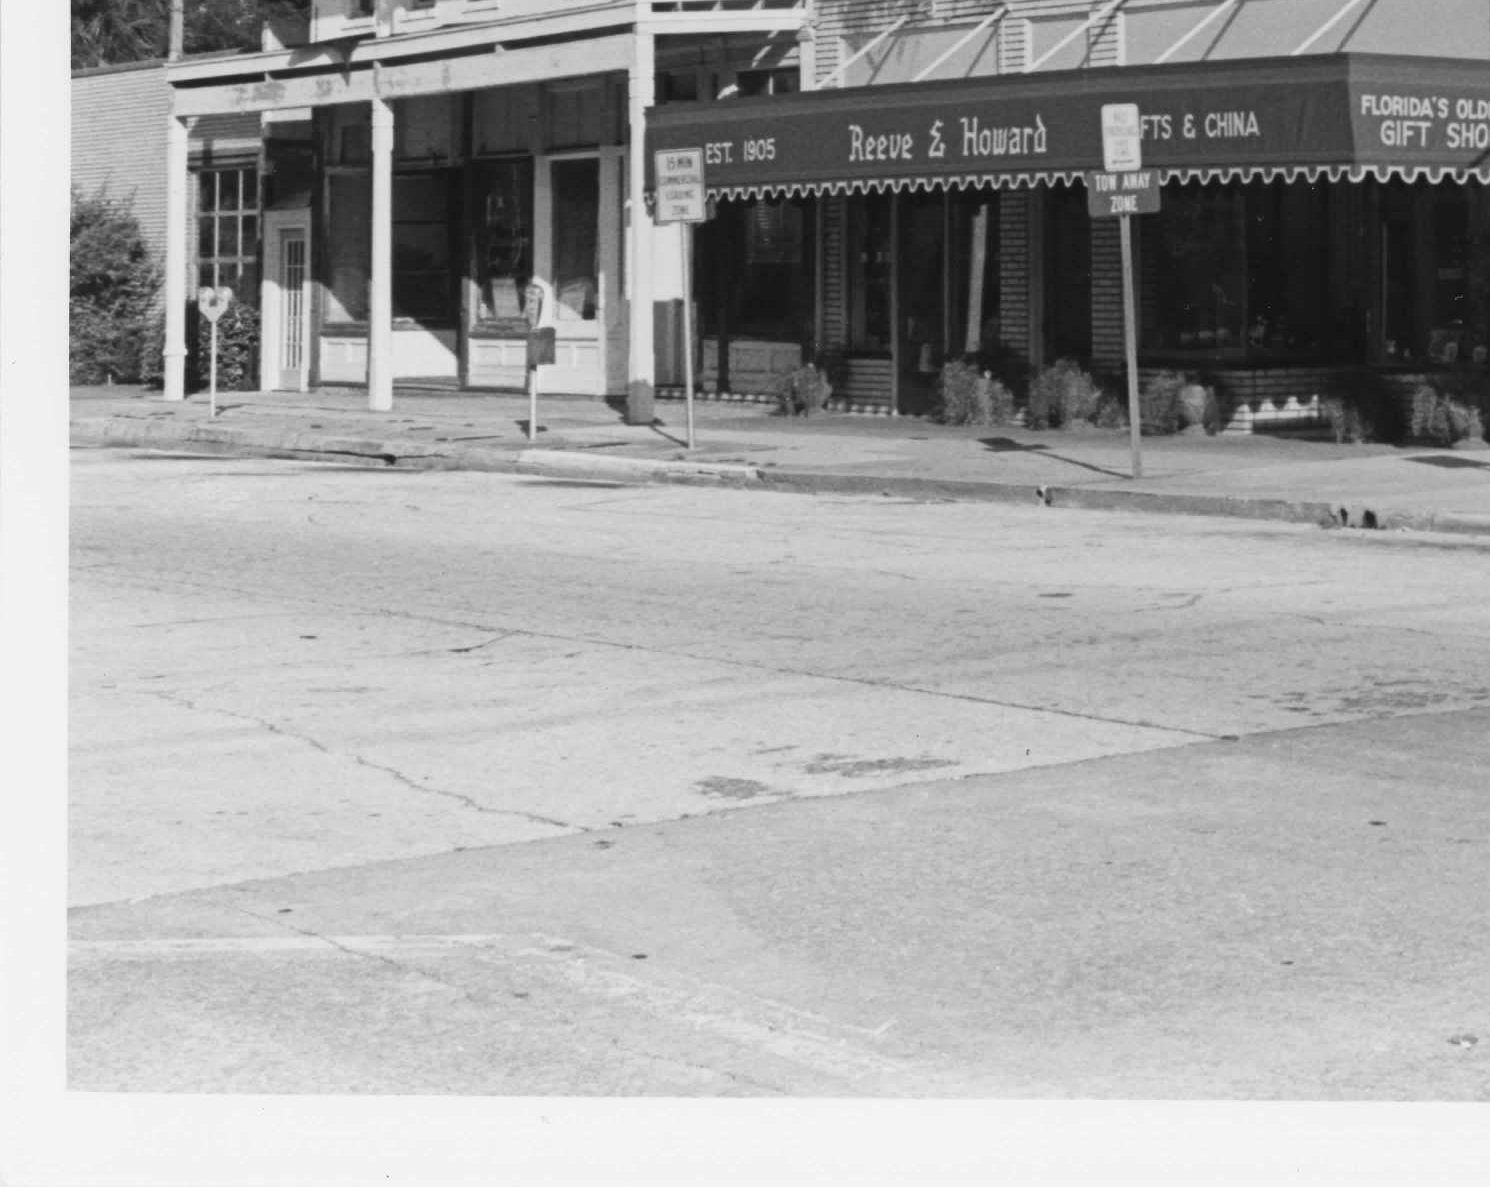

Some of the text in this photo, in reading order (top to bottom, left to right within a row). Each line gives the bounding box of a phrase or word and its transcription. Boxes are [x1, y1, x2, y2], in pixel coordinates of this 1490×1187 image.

[1360, 94, 1449, 119] FLORIDA'S
[848, 124, 913, 162] Reeve
[960, 113, 1047, 157] Howard
[1140, 114, 1172, 140] FTS
[1183, 113, 1196, 139] &
[1204, 110, 1261, 138] CHINA
[1380, 120, 1432, 148] GIFT
[705, 137, 776, 164] EST. 1905
[1094, 172, 1152, 192] TOW AWAY
[1109, 194, 1139, 213] ZONE
